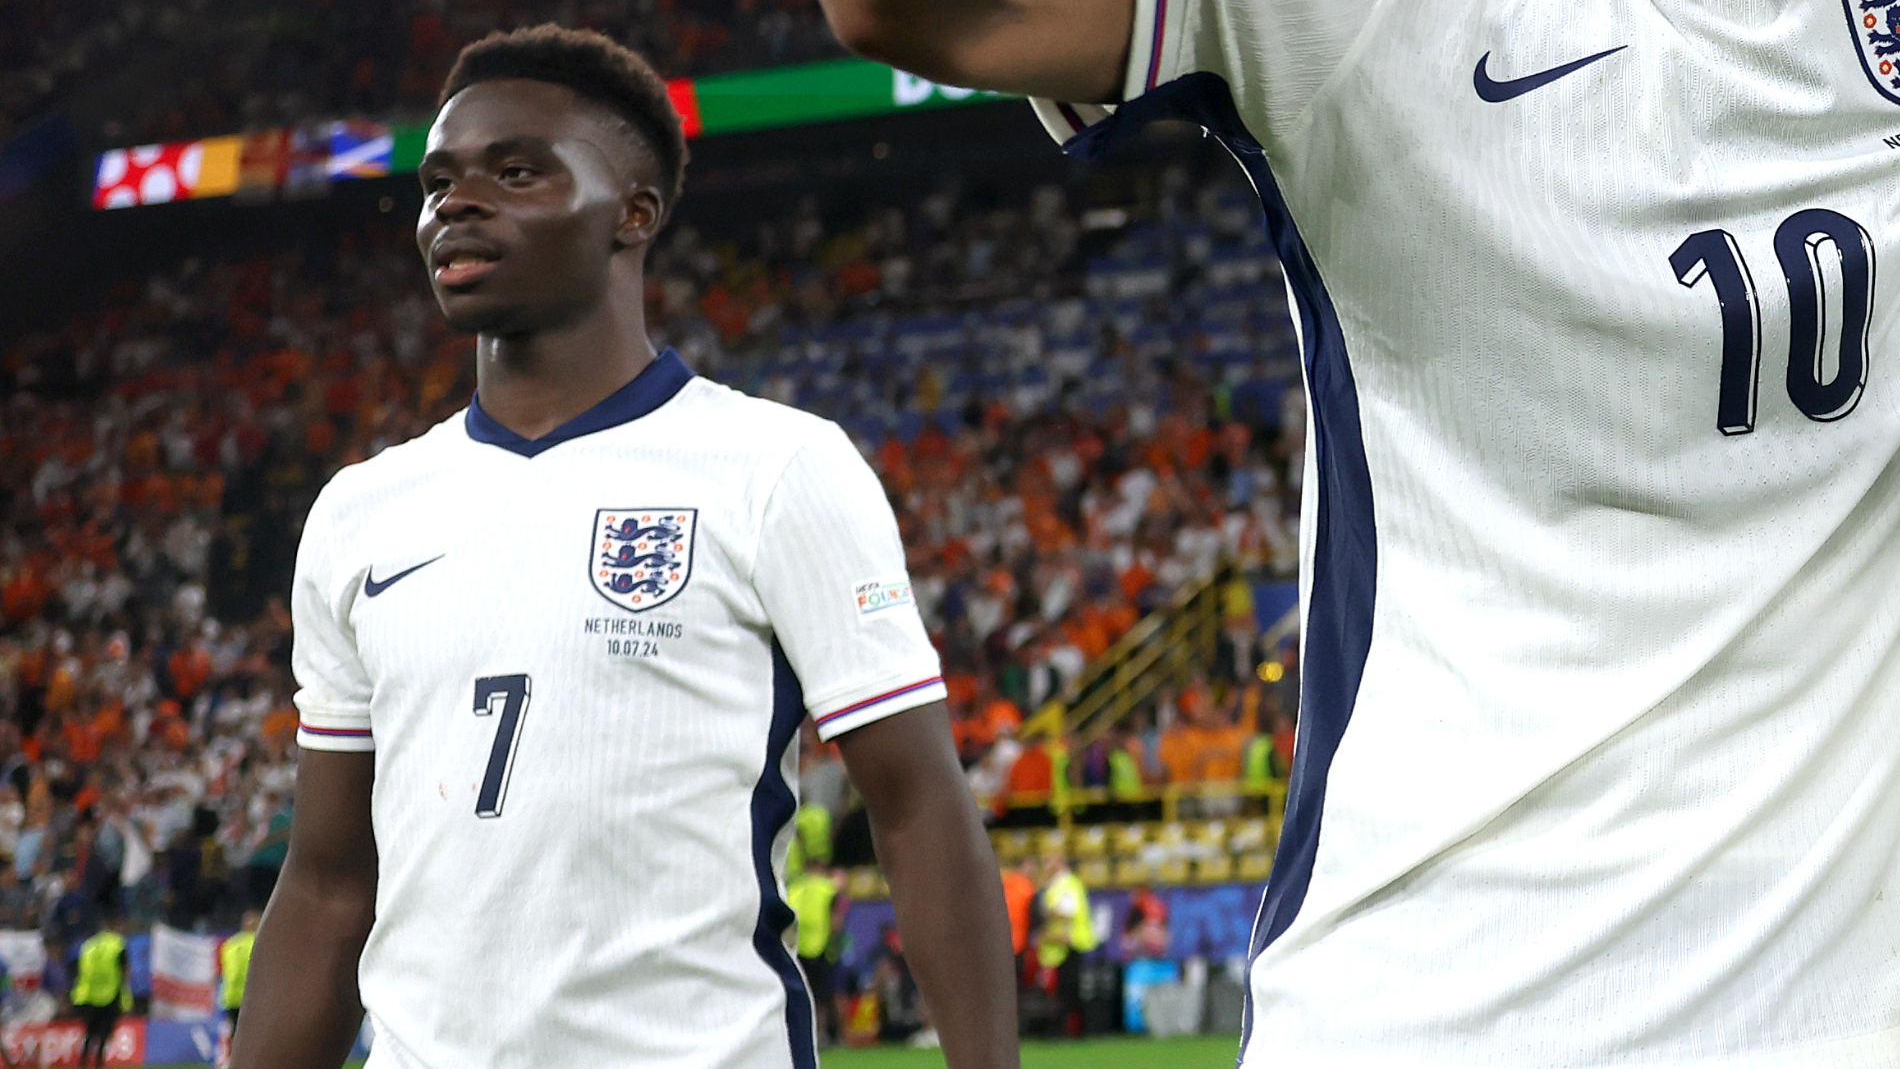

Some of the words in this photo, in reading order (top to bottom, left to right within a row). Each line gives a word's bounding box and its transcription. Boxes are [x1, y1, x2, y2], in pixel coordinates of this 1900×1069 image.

[1668, 208, 1876, 436] 10
[584, 618, 683, 639] NETHERLANDS
[607, 639, 658, 657] 10.07.24
[472, 673, 532, 819] 7
